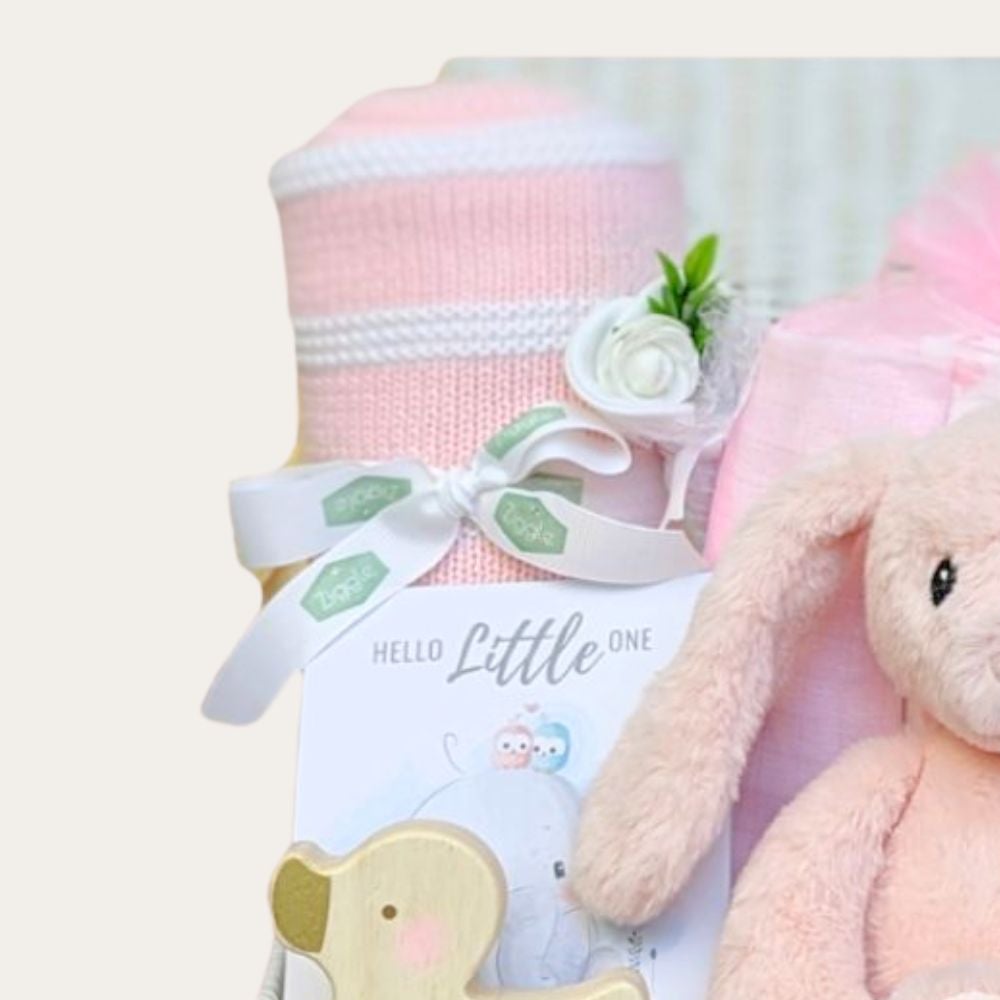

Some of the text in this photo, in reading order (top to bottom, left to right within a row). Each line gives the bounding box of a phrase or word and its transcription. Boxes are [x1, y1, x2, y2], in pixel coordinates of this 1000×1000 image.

[372, 611, 653, 688] HELLO Little ONE
